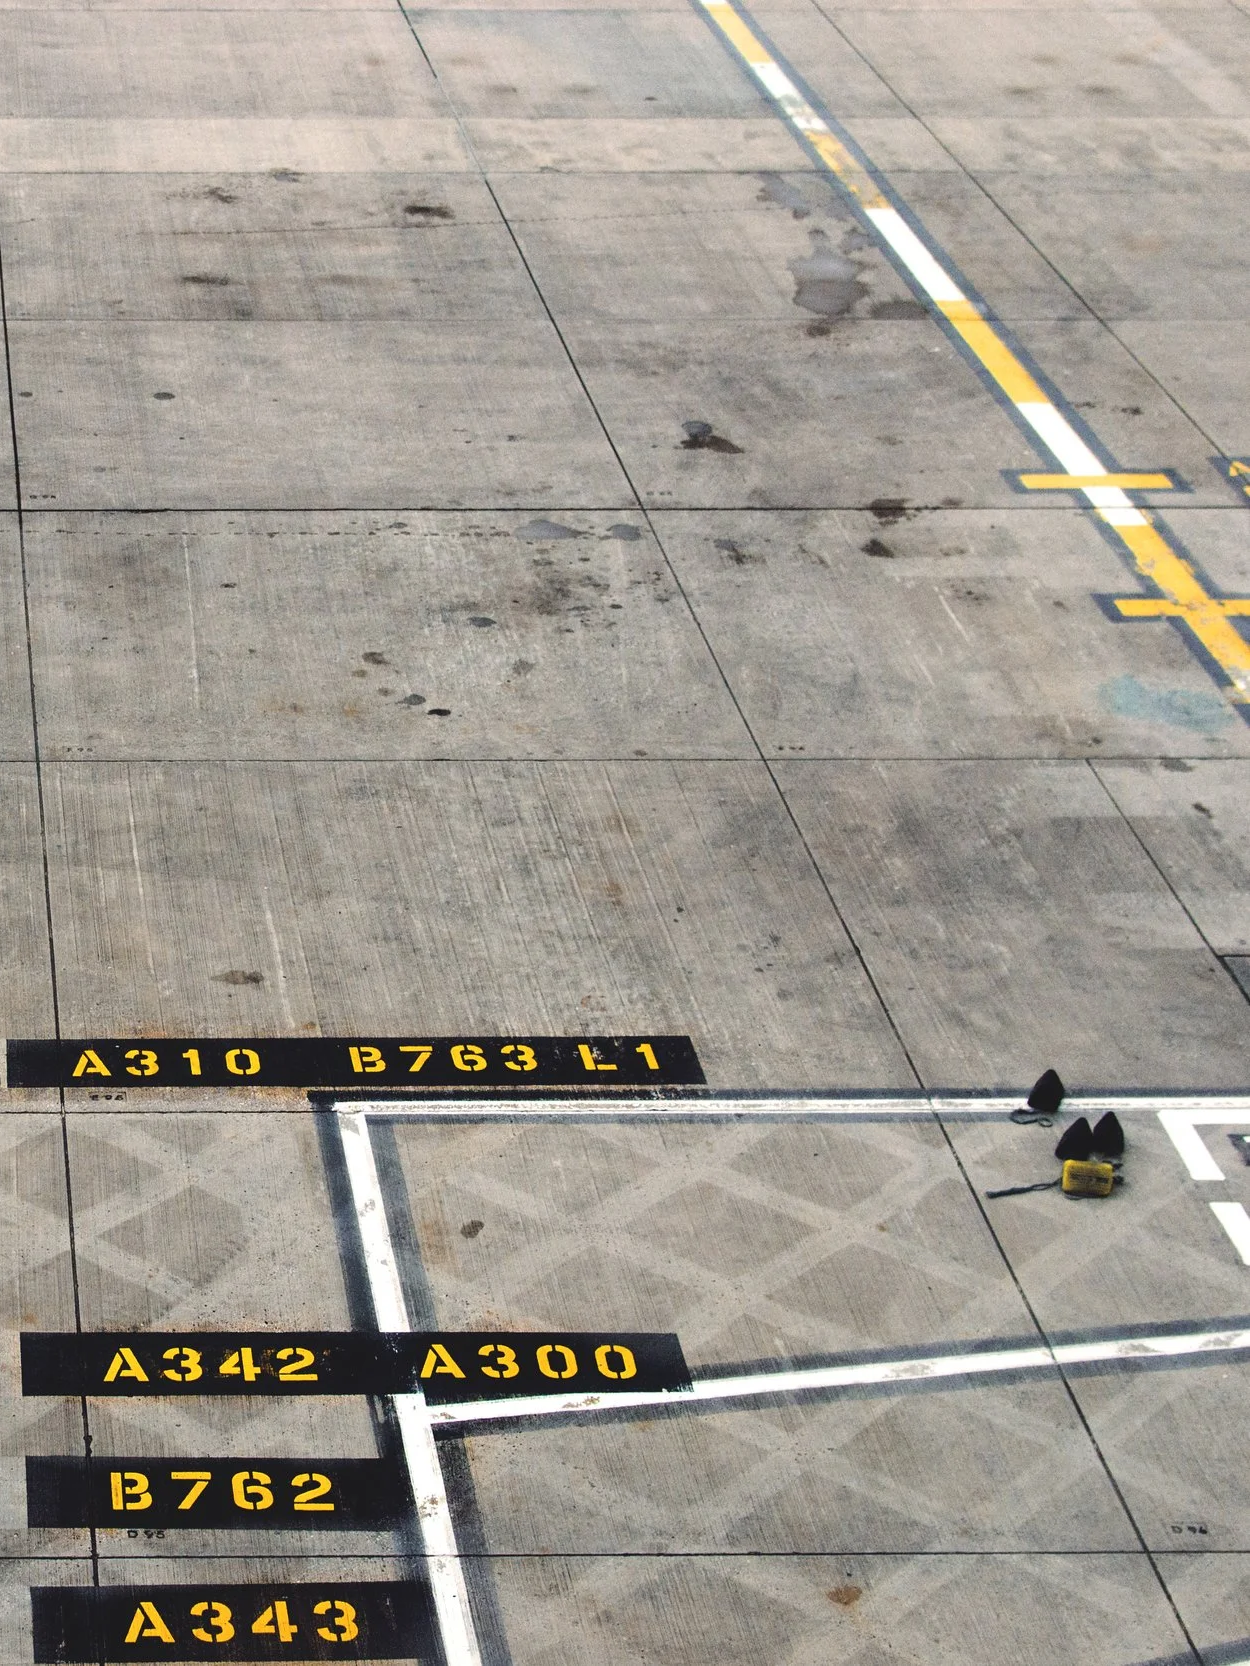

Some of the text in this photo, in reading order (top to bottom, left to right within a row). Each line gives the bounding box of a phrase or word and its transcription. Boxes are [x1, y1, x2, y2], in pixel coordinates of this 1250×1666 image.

[72, 1048, 261, 1077] A310
[348, 1043, 538, 1073] B763
[103, 1343, 638, 1382] A342 A300
[110, 1471, 335, 1512] B762
[124, 1600, 359, 1643] A343
